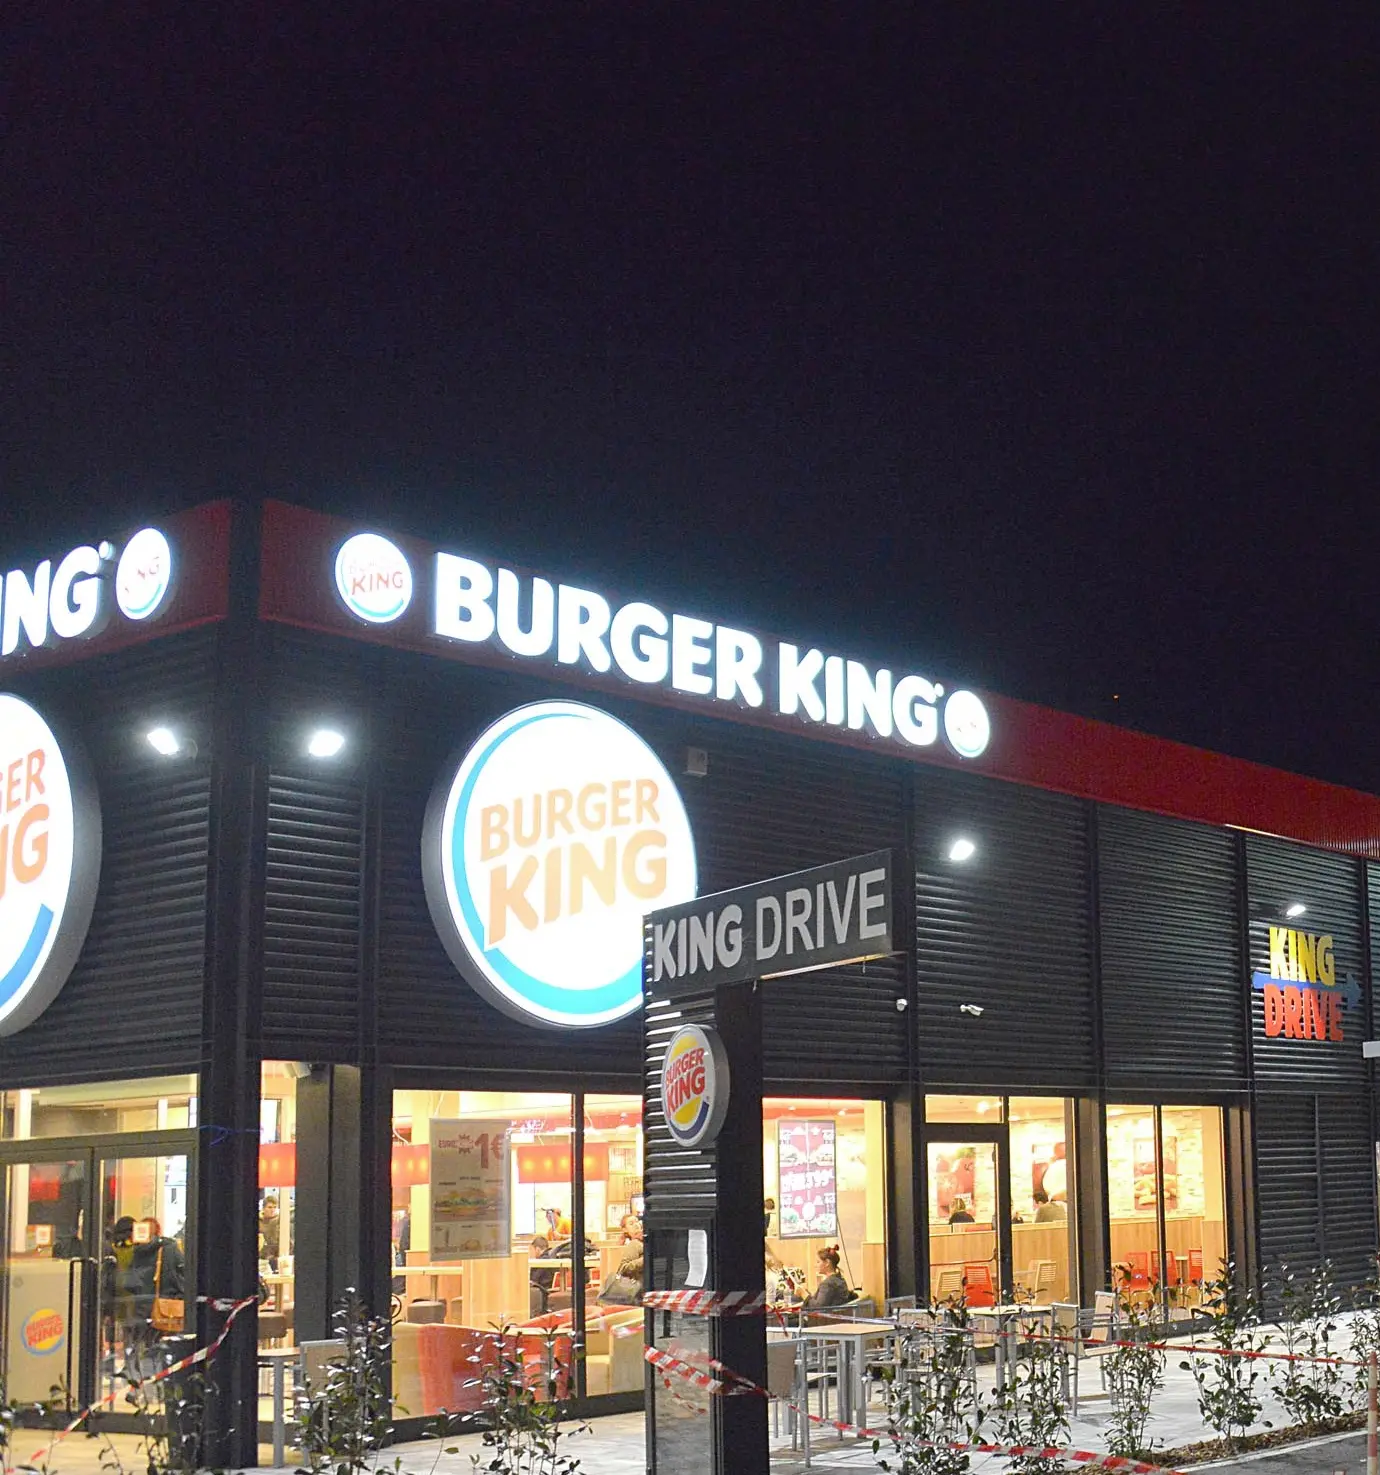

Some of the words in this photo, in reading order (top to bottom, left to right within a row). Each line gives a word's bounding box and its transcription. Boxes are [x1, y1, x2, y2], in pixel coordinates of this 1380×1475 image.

[351, 571, 404, 595] KING
[434, 552, 763, 707] BURGER
[778, 641, 938, 746] KING
[480, 779, 661, 862] BURGER
[488, 829, 668, 946] KING
[652, 903, 743, 982] KING
[755, 867, 887, 961] DRIVE
[1269, 926, 1336, 986] KING
[1264, 983, 1344, 1041] DRIVE
[665, 1047, 705, 1088] BURGER
[667, 1066, 706, 1119] KING
